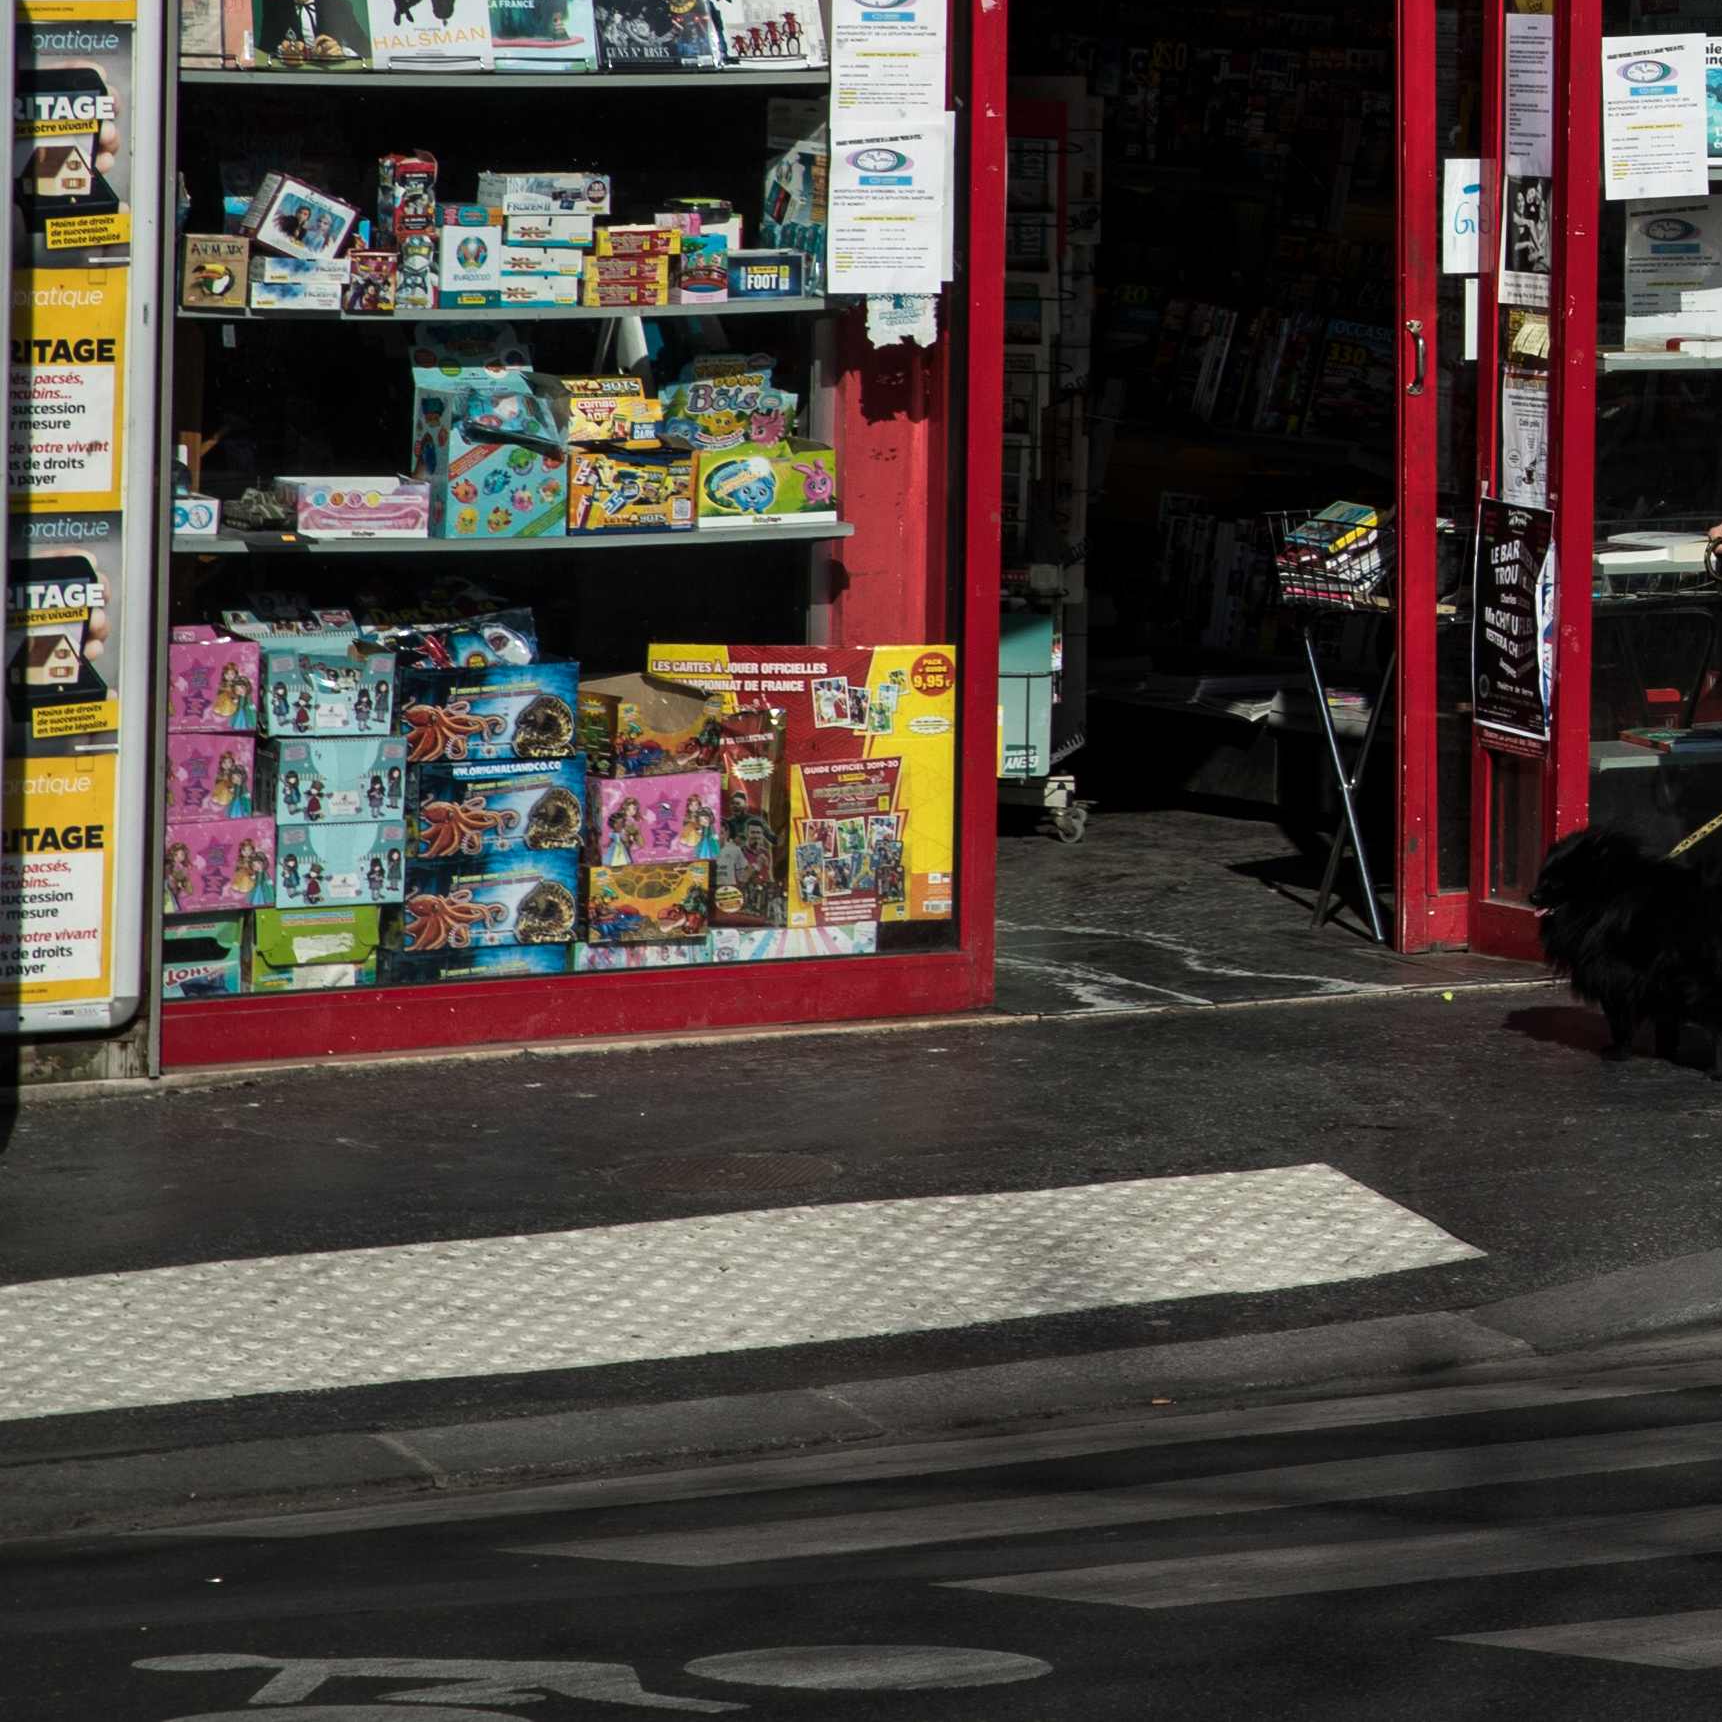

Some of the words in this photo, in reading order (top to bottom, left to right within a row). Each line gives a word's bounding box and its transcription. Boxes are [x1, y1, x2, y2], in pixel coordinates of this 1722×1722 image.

[499, 0, 535, 9] FRANCE
[373, 29, 487, 50] HALSMAN
[747, 274, 779, 289] FOOT
[1491, 547, 1501, 565] LE
[1500, 539, 1521, 563] BAR
[652, 661, 671, 672] LES
[672, 661, 712, 673] CARTES
[714, 659, 723, 673] À
[724, 662, 757, 674] JOUER
[758, 662, 828, 675] OFFICIELLES
[682, 679, 744, 692] AMPIONNAT
[744, 680, 760, 691] DE
[763, 679, 805, 692] FRANCE
